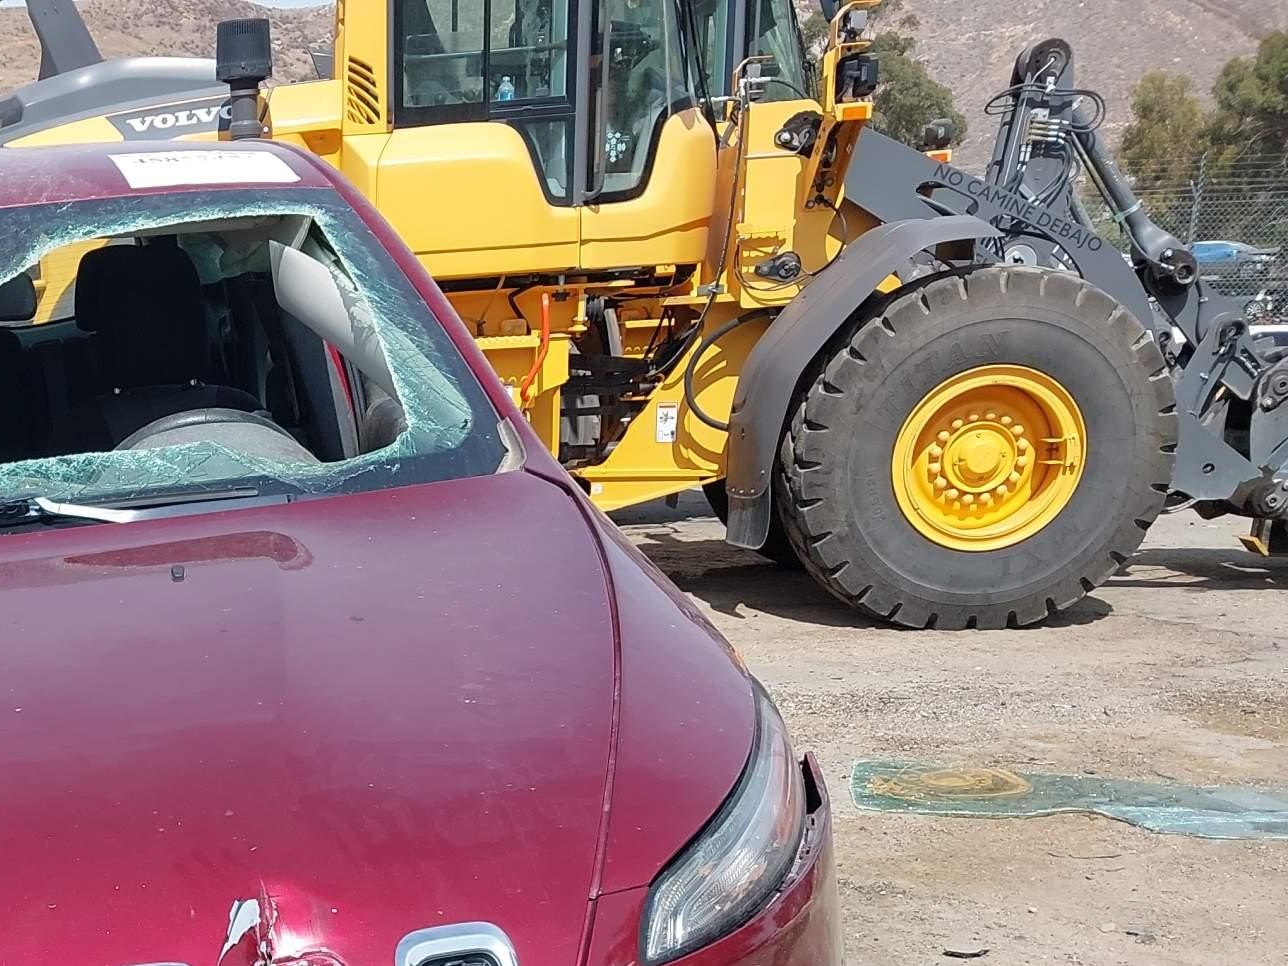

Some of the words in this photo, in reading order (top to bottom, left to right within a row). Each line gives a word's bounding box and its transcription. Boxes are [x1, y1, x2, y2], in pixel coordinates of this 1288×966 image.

[933, 164, 963, 187] NO
[967, 180, 1037, 220] CAMINE
[1036, 212, 1103, 252] DEBAJO
